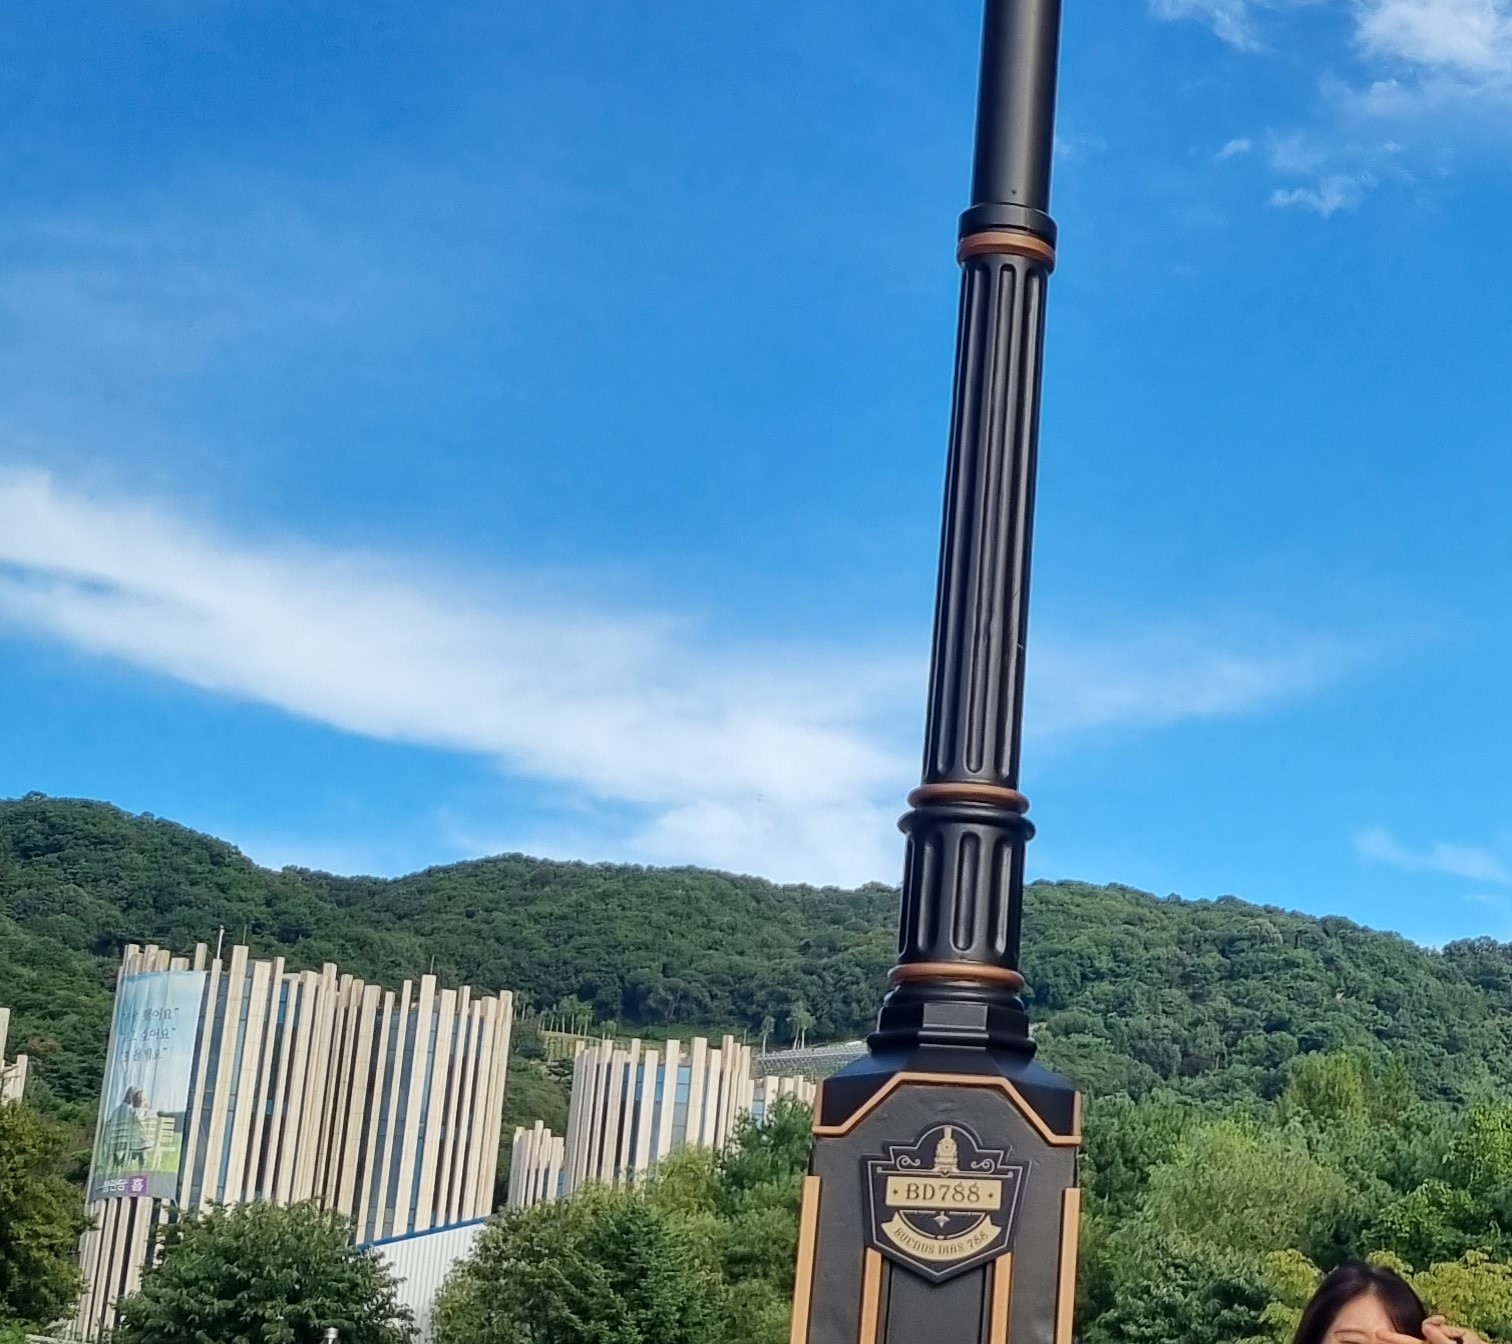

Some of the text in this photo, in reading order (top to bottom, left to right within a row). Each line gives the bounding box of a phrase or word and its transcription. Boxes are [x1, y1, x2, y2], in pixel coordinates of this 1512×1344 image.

[906, 1181, 981, 1203] BD788
[894, 1226, 990, 1256] BUENOS DIAS 788
